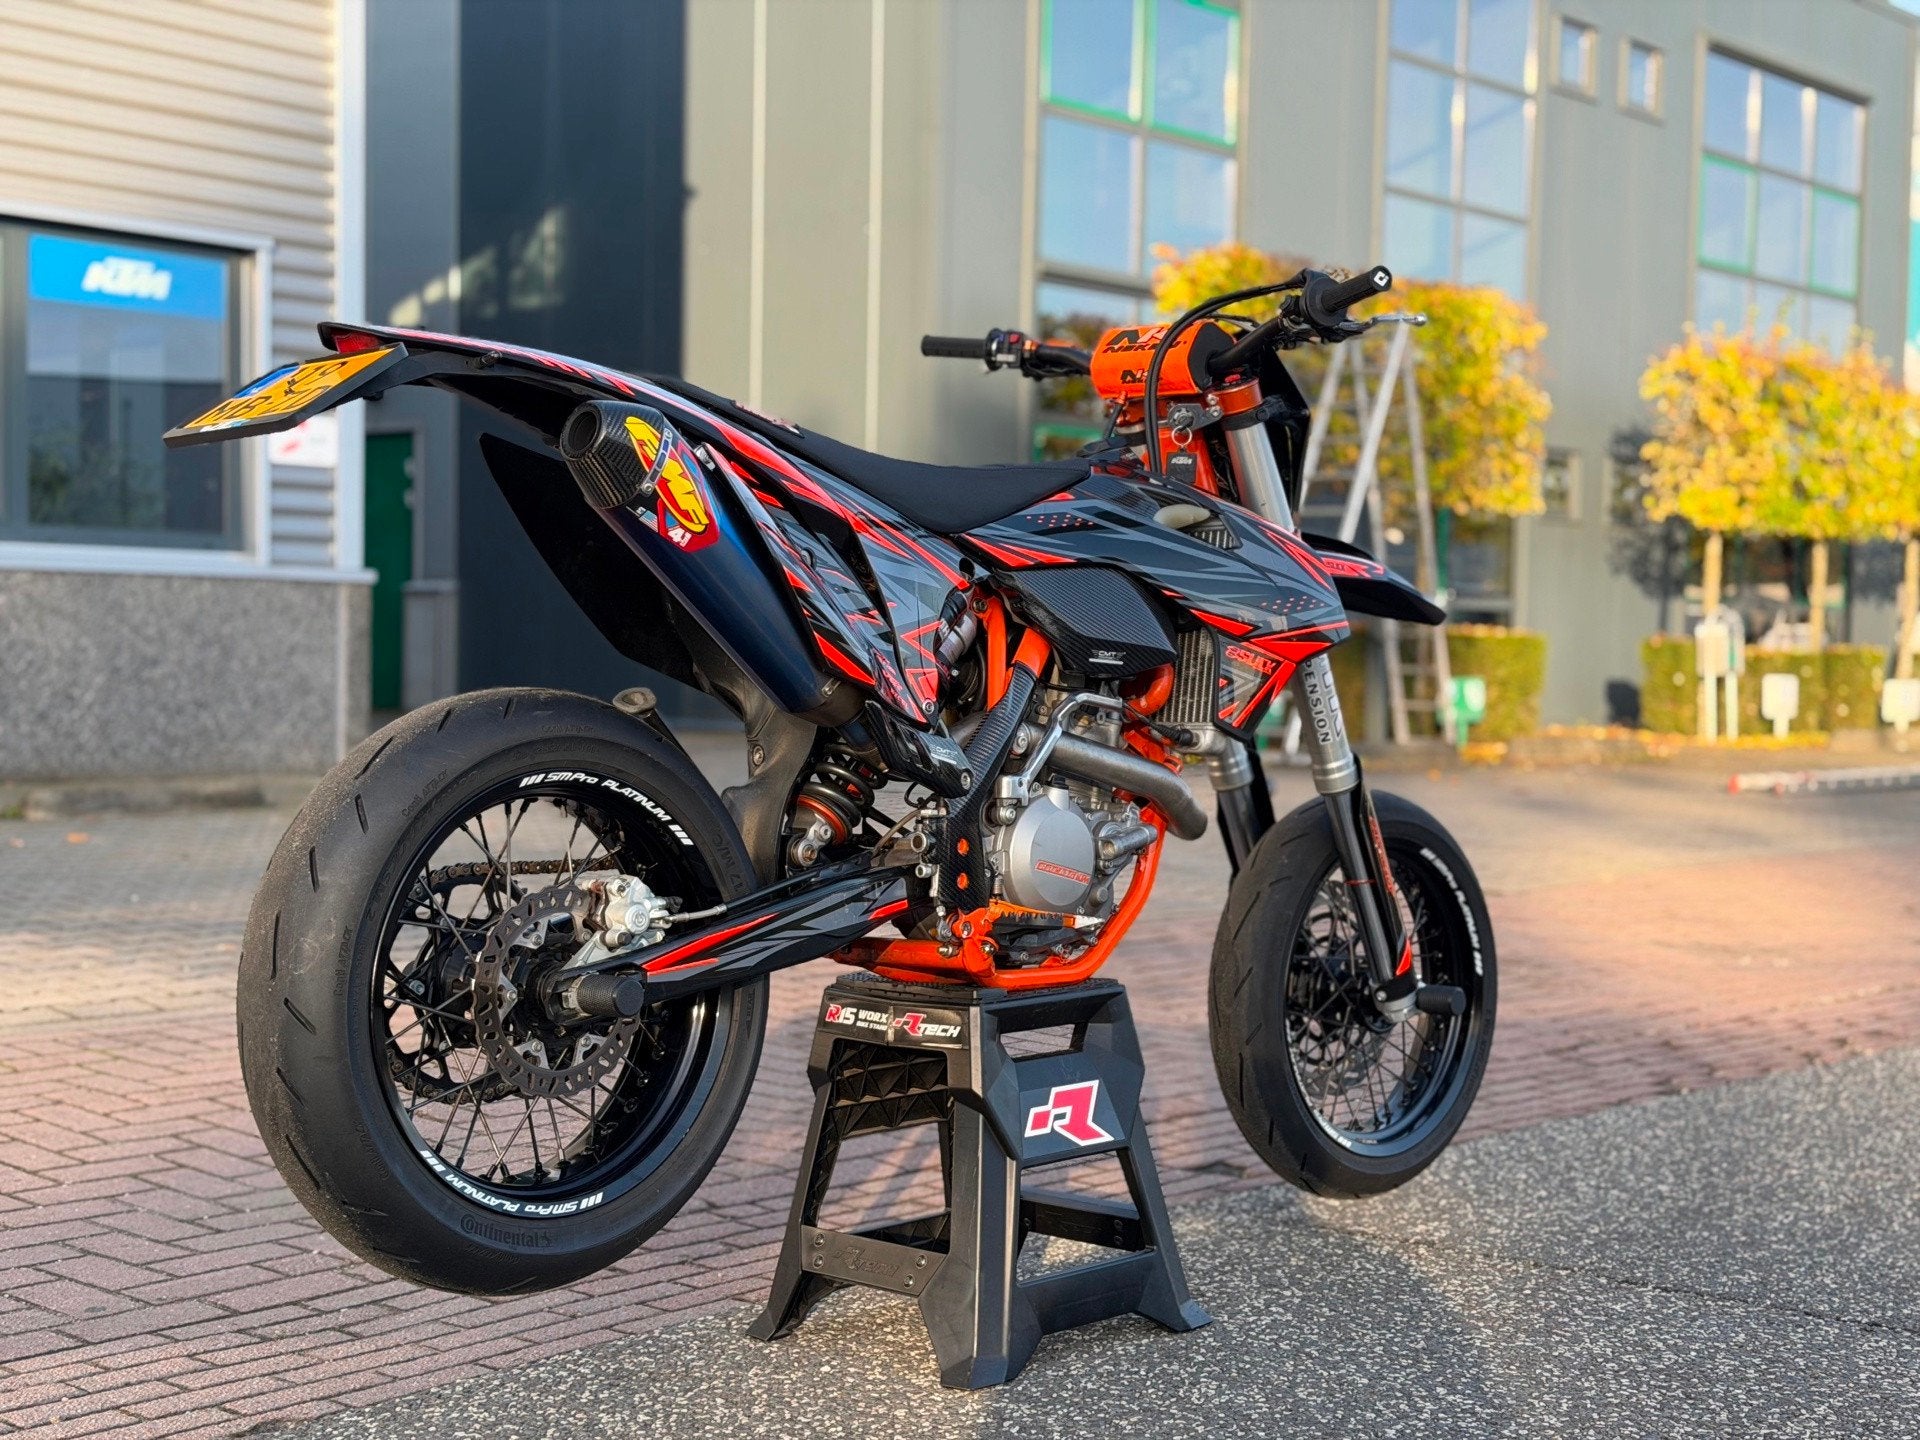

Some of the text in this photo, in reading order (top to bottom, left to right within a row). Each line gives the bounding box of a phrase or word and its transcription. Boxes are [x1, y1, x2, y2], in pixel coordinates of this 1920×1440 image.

[601, 779, 673, 822] PLATINUM
[825, 1003, 890, 1025] R15 WORX
[445, 1173, 521, 1213] PLATINUM
[460, 1213, 540, 1247] Continental
